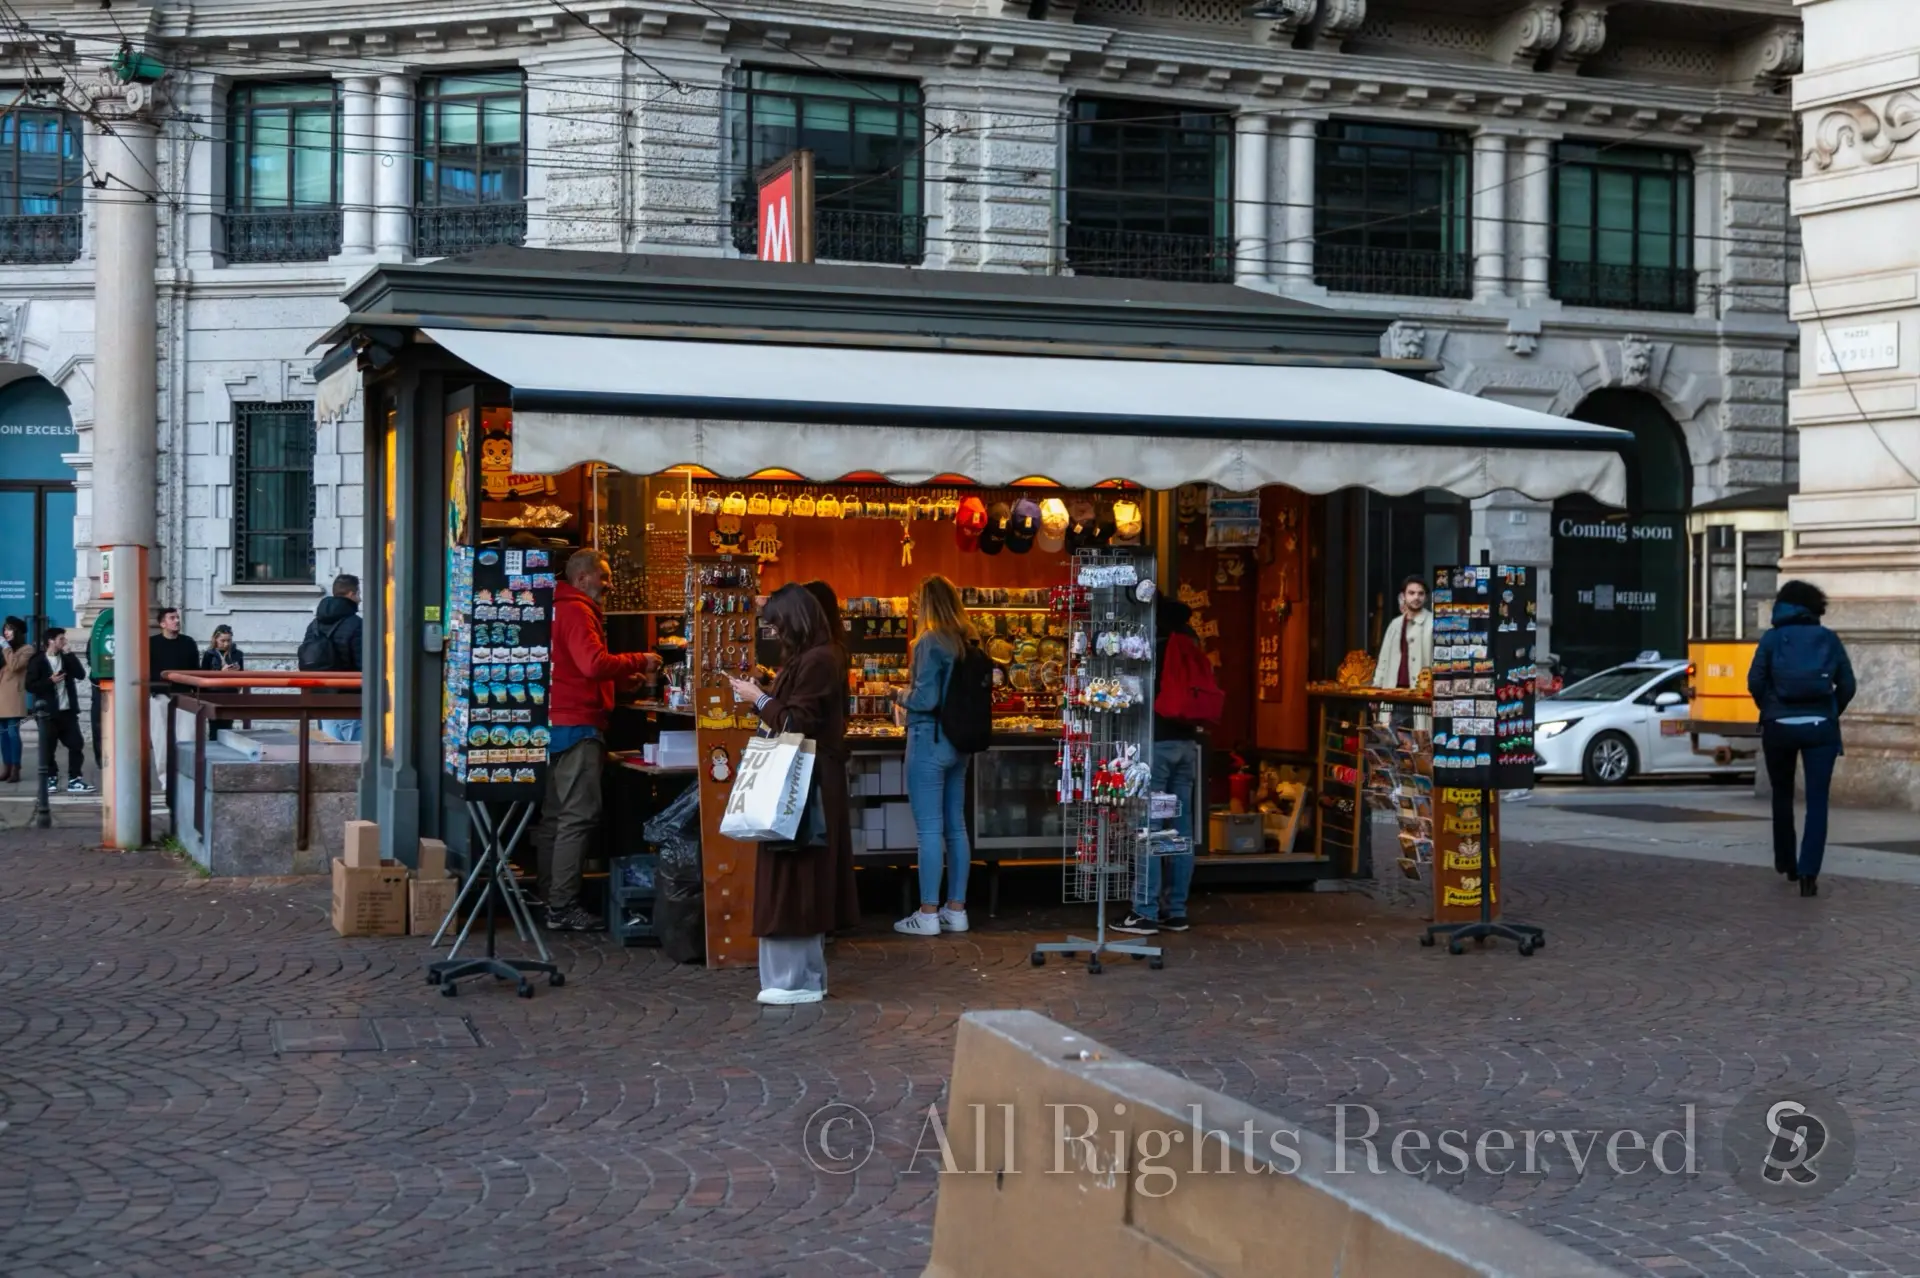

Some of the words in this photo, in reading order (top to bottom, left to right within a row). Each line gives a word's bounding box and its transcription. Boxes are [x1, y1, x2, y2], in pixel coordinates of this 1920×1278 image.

[763, 195, 792, 262] M
[26, 425, 77, 435] EXCELSI
[1560, 518, 1627, 543] Coming
[1632, 525, 1672, 540] soon
[1578, 590, 1593, 603] THE
[784, 755, 804, 816] HUMANA
